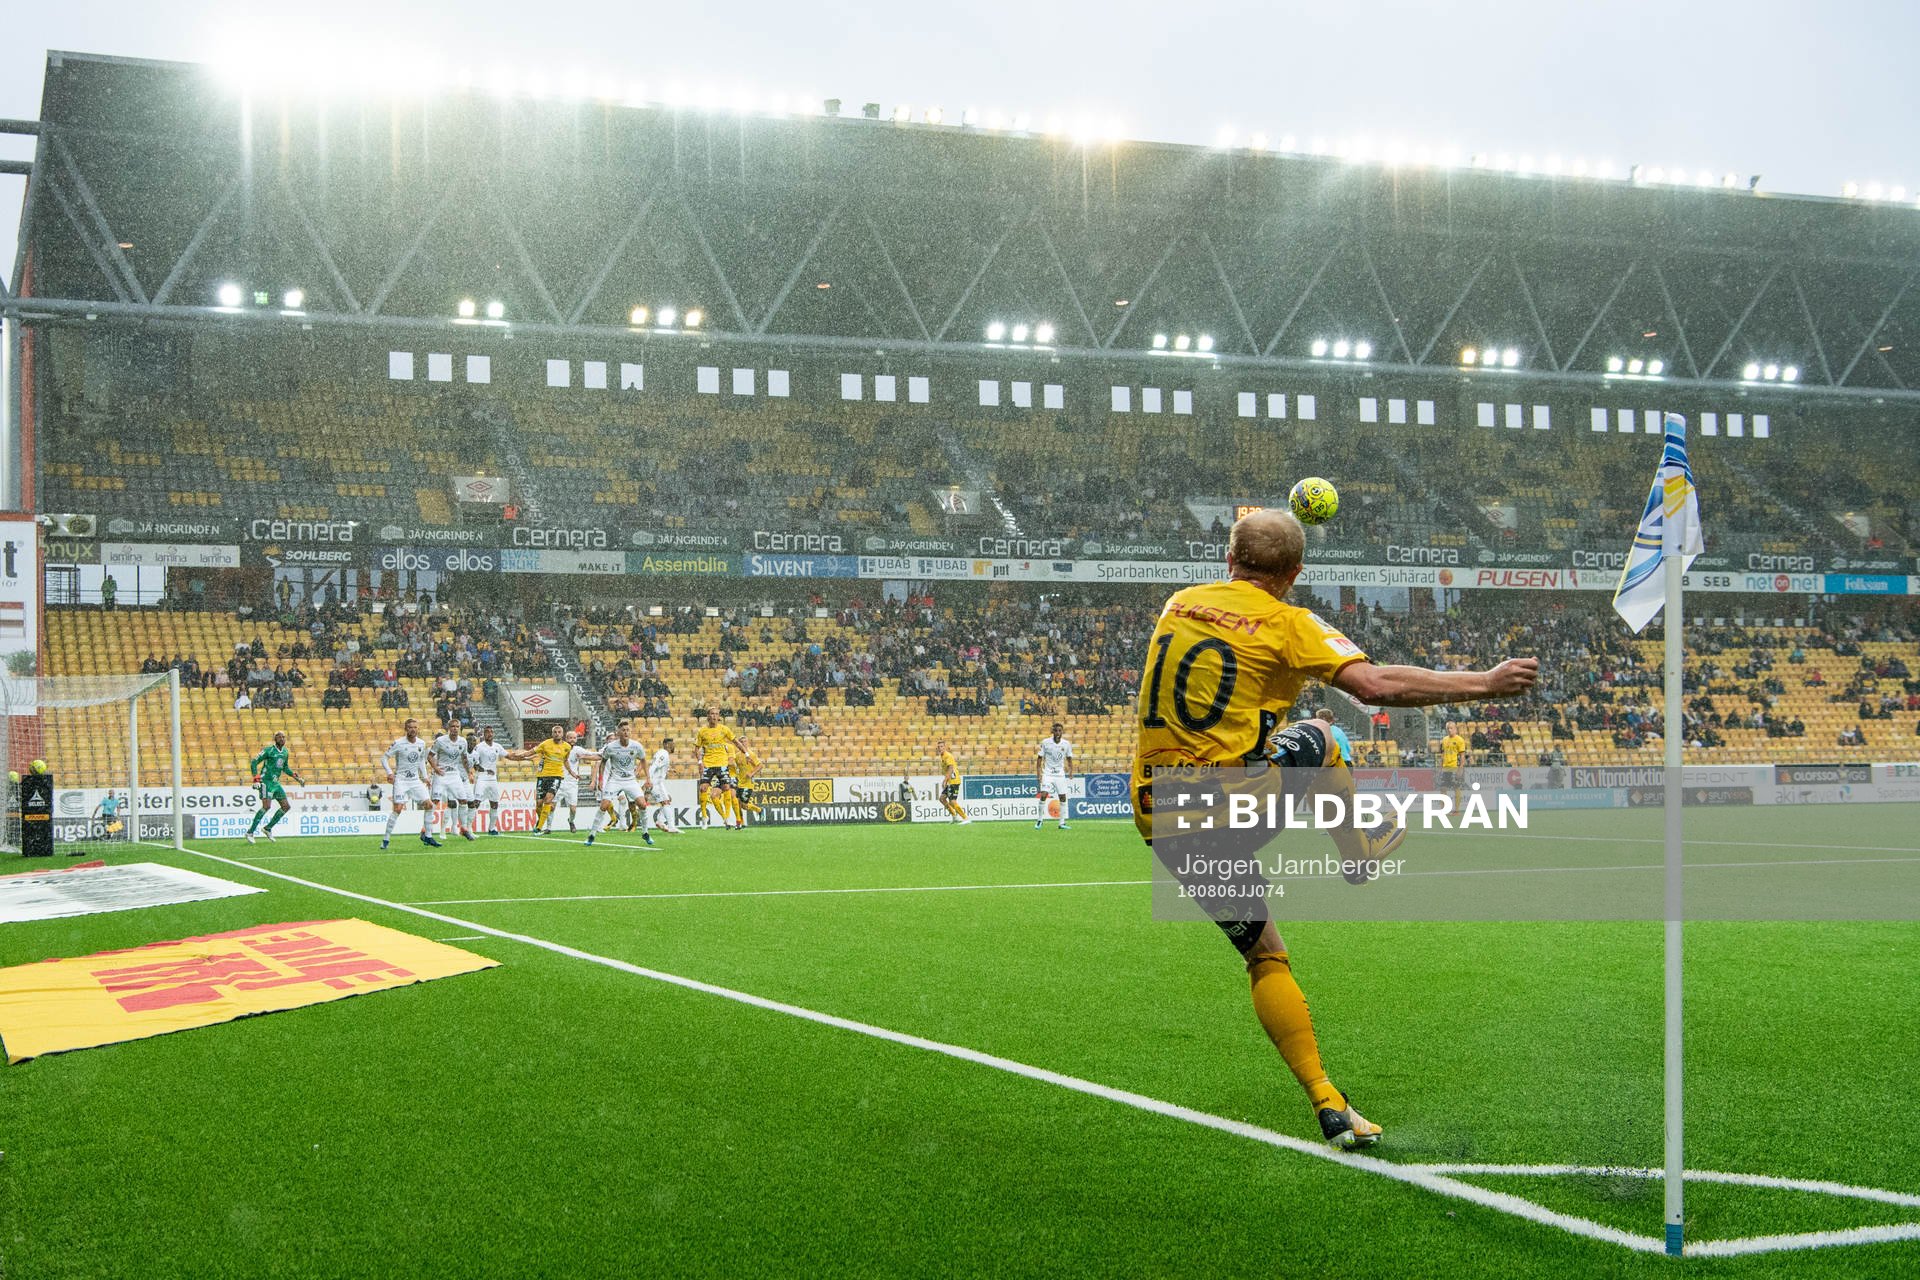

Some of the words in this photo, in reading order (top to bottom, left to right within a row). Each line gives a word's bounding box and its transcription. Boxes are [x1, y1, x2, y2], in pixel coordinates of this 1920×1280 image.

[252, 520, 353, 542] Cernera
[513, 527, 607, 548] Cernera
[754, 531, 842, 552] Cernera
[979, 536, 1061, 557] Cernera
[110, 551, 143, 562] lamina
[155, 552, 187, 563] lamina
[199, 552, 232, 564] lamina
[285, 550, 352, 562] SOHLBERG
[381, 548, 430, 570] ellos
[446, 548, 493, 571] ellos
[1386, 545, 1458, 564] Cernera
[1572, 550, 1630, 567] Cerne
[1748, 553, 1813, 571] Cernera
[578, 563, 609, 572] MAKE
[642, 556, 728, 573] Assemblin
[751, 555, 814, 577] SILVENT
[878, 558, 911, 569] UBAB
[935, 560, 967, 571] UBAB
[1097, 563, 1178, 580] Sparbanken
[1182, 564, 1230, 581] Sjuhära
[1300, 567, 1376, 583] Sparbanken
[1379, 568, 1435, 585] Sjuhärad
[1477, 570, 1558, 588] PULSEN
[1581, 572, 1622, 586] Riksby
[1703, 576, 1731, 588] SEB
[1167, 602, 1263, 636] PULSEN
[1142, 633, 1238, 732] 10
[982, 783, 1038, 796] Danske
[322, 815, 336, 824] AB
[770, 805, 878, 822] TILLSAMMANS
[991, 803, 1039, 819] Sjuhära
[222, 816, 237, 826] AB
[328, 825, 360, 834] BORÅS
